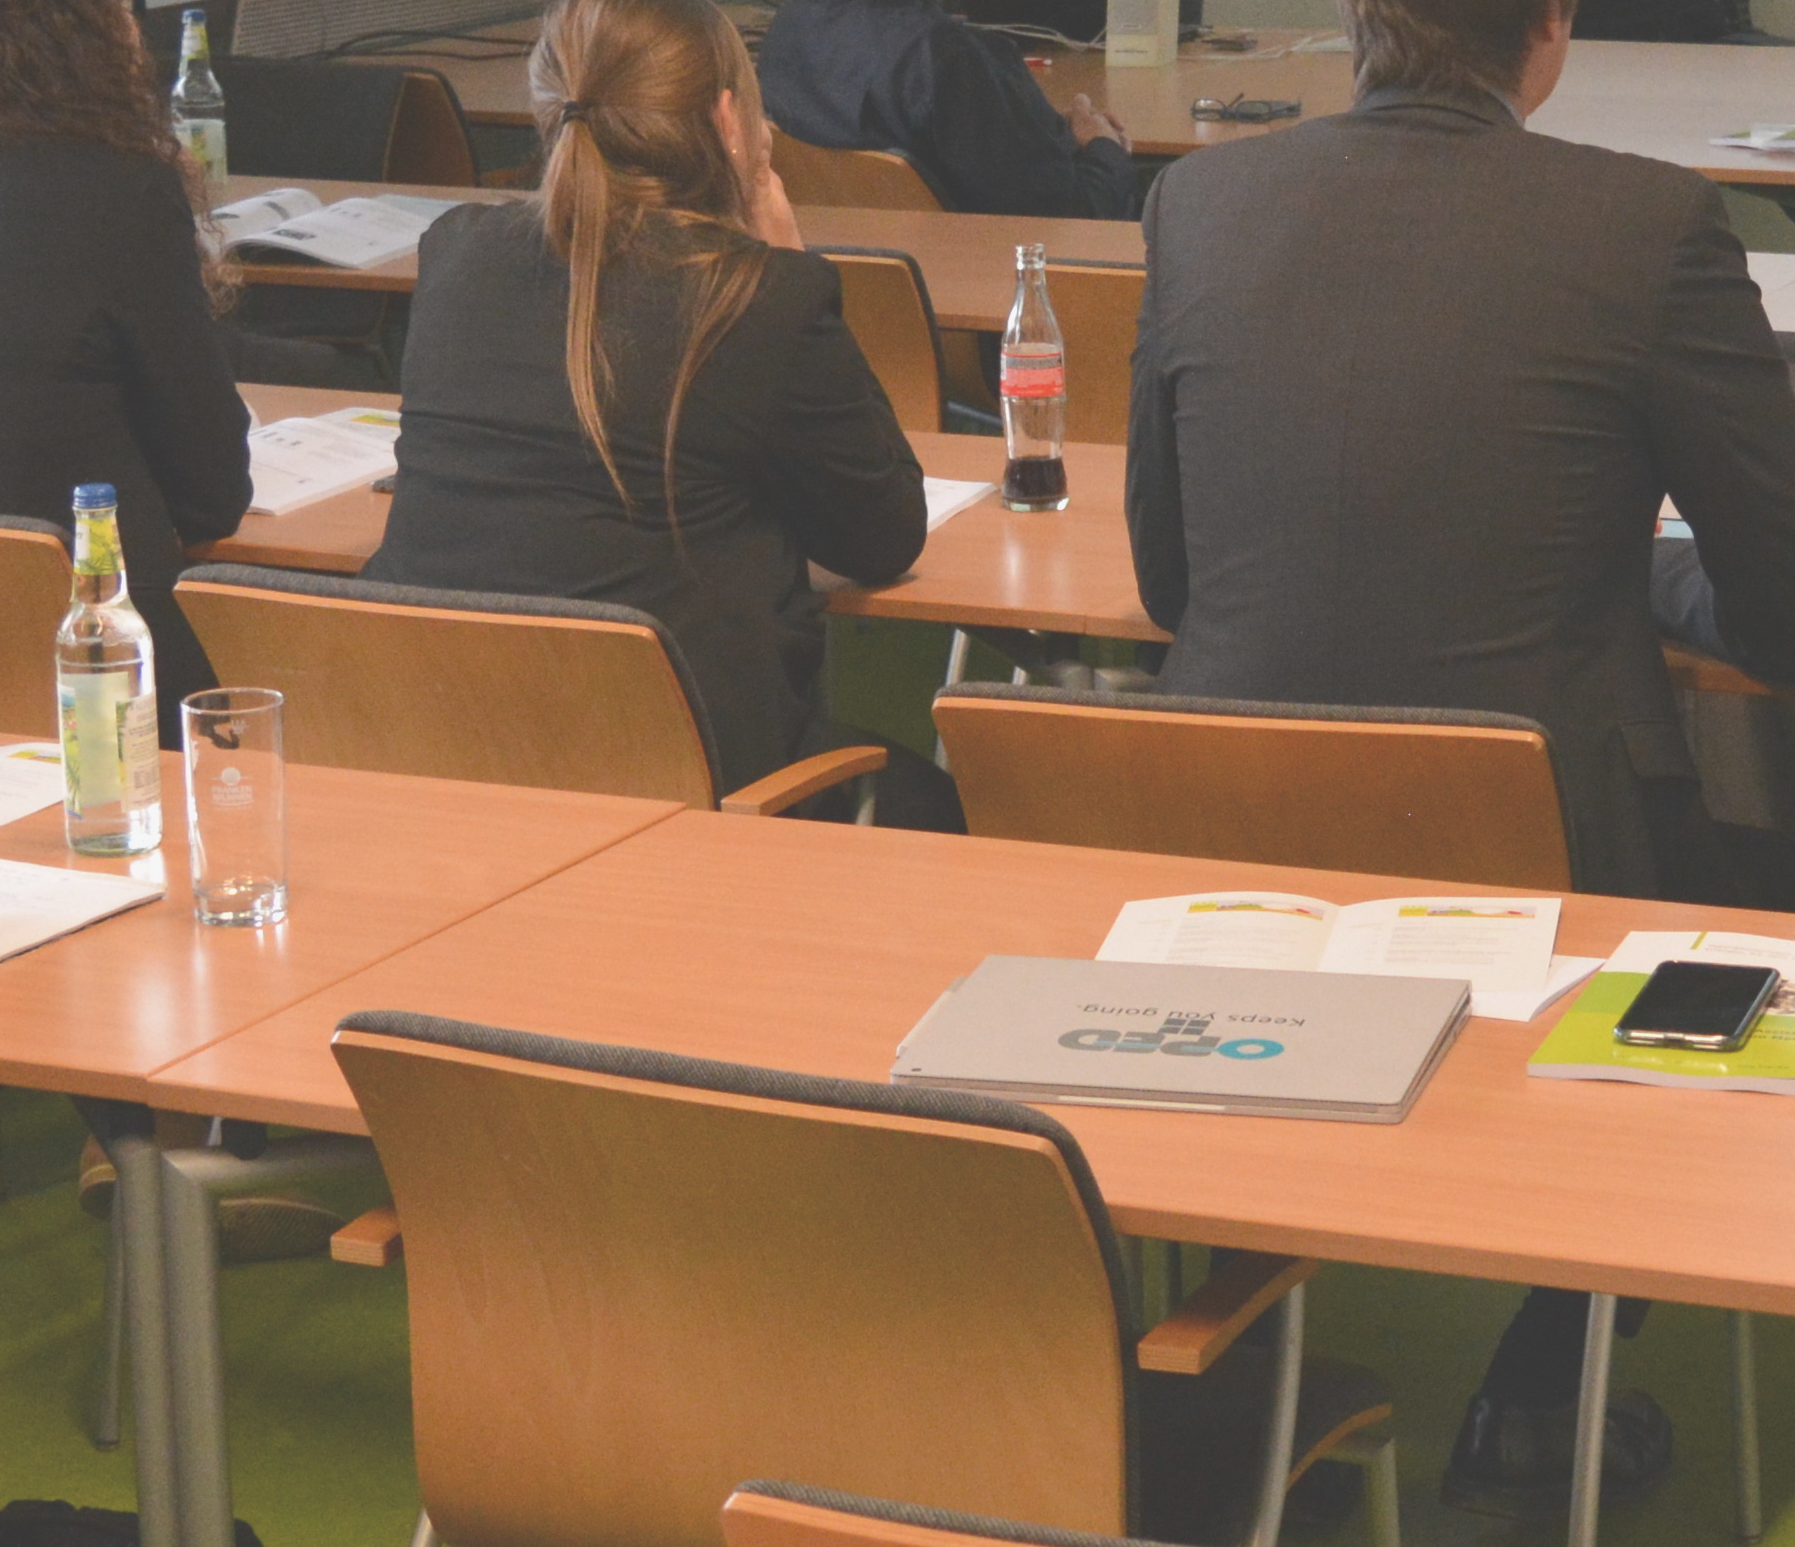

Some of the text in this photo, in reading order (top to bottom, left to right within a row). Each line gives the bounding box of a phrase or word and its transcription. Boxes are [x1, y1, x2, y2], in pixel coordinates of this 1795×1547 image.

[1167, 1009, 1218, 1022] you
[1227, 1013, 1306, 1029] Keeps
[1057, 1027, 1287, 1061] OPED
